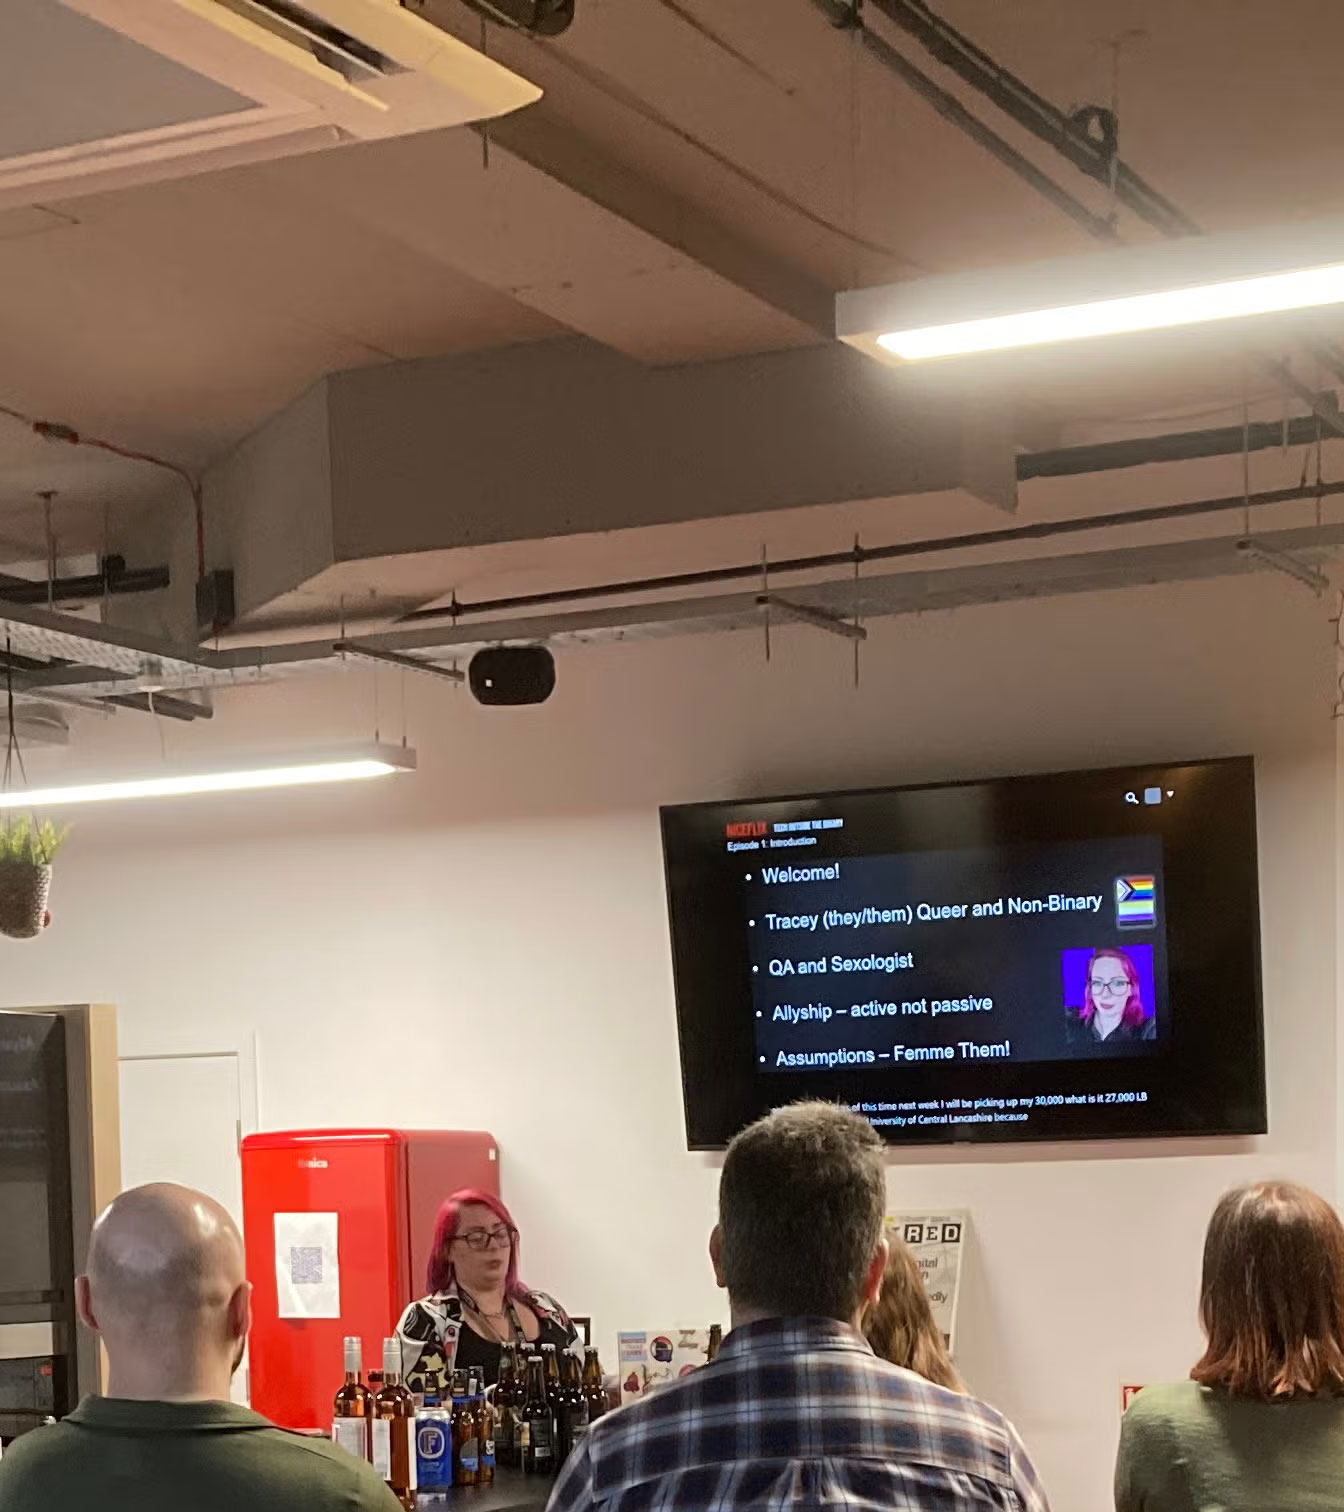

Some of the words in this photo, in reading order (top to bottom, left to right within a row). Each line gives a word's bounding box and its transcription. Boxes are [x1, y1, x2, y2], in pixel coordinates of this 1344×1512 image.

[727, 841, 759, 852] Episode
[770, 837, 817, 848] Introduction
[761, 863, 840, 884] Welcome!
[765, 913, 819, 931] Tracey
[823, 904, 912, 930] (they/them)
[916, 903, 968, 921] Queer
[972, 899, 1003, 917] and
[1008, 894, 1102, 913] Non-Binary
[769, 958, 795, 976] QA
[798, 957, 826, 975] and
[831, 952, 914, 973] Sexologist
[773, 1003, 832, 1024] Allyship
[850, 1000, 897, 1018] active
[902, 998, 927, 1015] not
[931, 994, 993, 1016] passive
[776, 1048, 875, 1067] Assumptions
[894, 1044, 954, 1061] Femme
[958, 1040, 1010, 1059] Them!
[862, 1102, 877, 1111] this
[878, 1101, 897, 1111] time
[899, 1101, 917, 1110] next
[918, 1100, 939, 1109] week
[946, 1099, 960, 1109] will
[962, 1099, 973, 1108] be
[974, 1097, 1004, 1110] picking
[1006, 1098, 1018, 1108] up
[1020, 1098, 1033, 1108] my
[1035, 1095, 1064, 1106] 30,000
[1065, 1095, 1086, 1104] what
[1088, 1094, 1095, 1103] is
[1097, 1094, 1104, 1103] it
[1105, 1093, 1135, 1103] 27,000
[907, 1115, 917, 1124] of
[918, 1114, 947, 1124] Central
[949, 1112, 993, 1123] Lancashire
[994, 1112, 1028, 1121] because
[894, 1223, 961, 1243] RED
